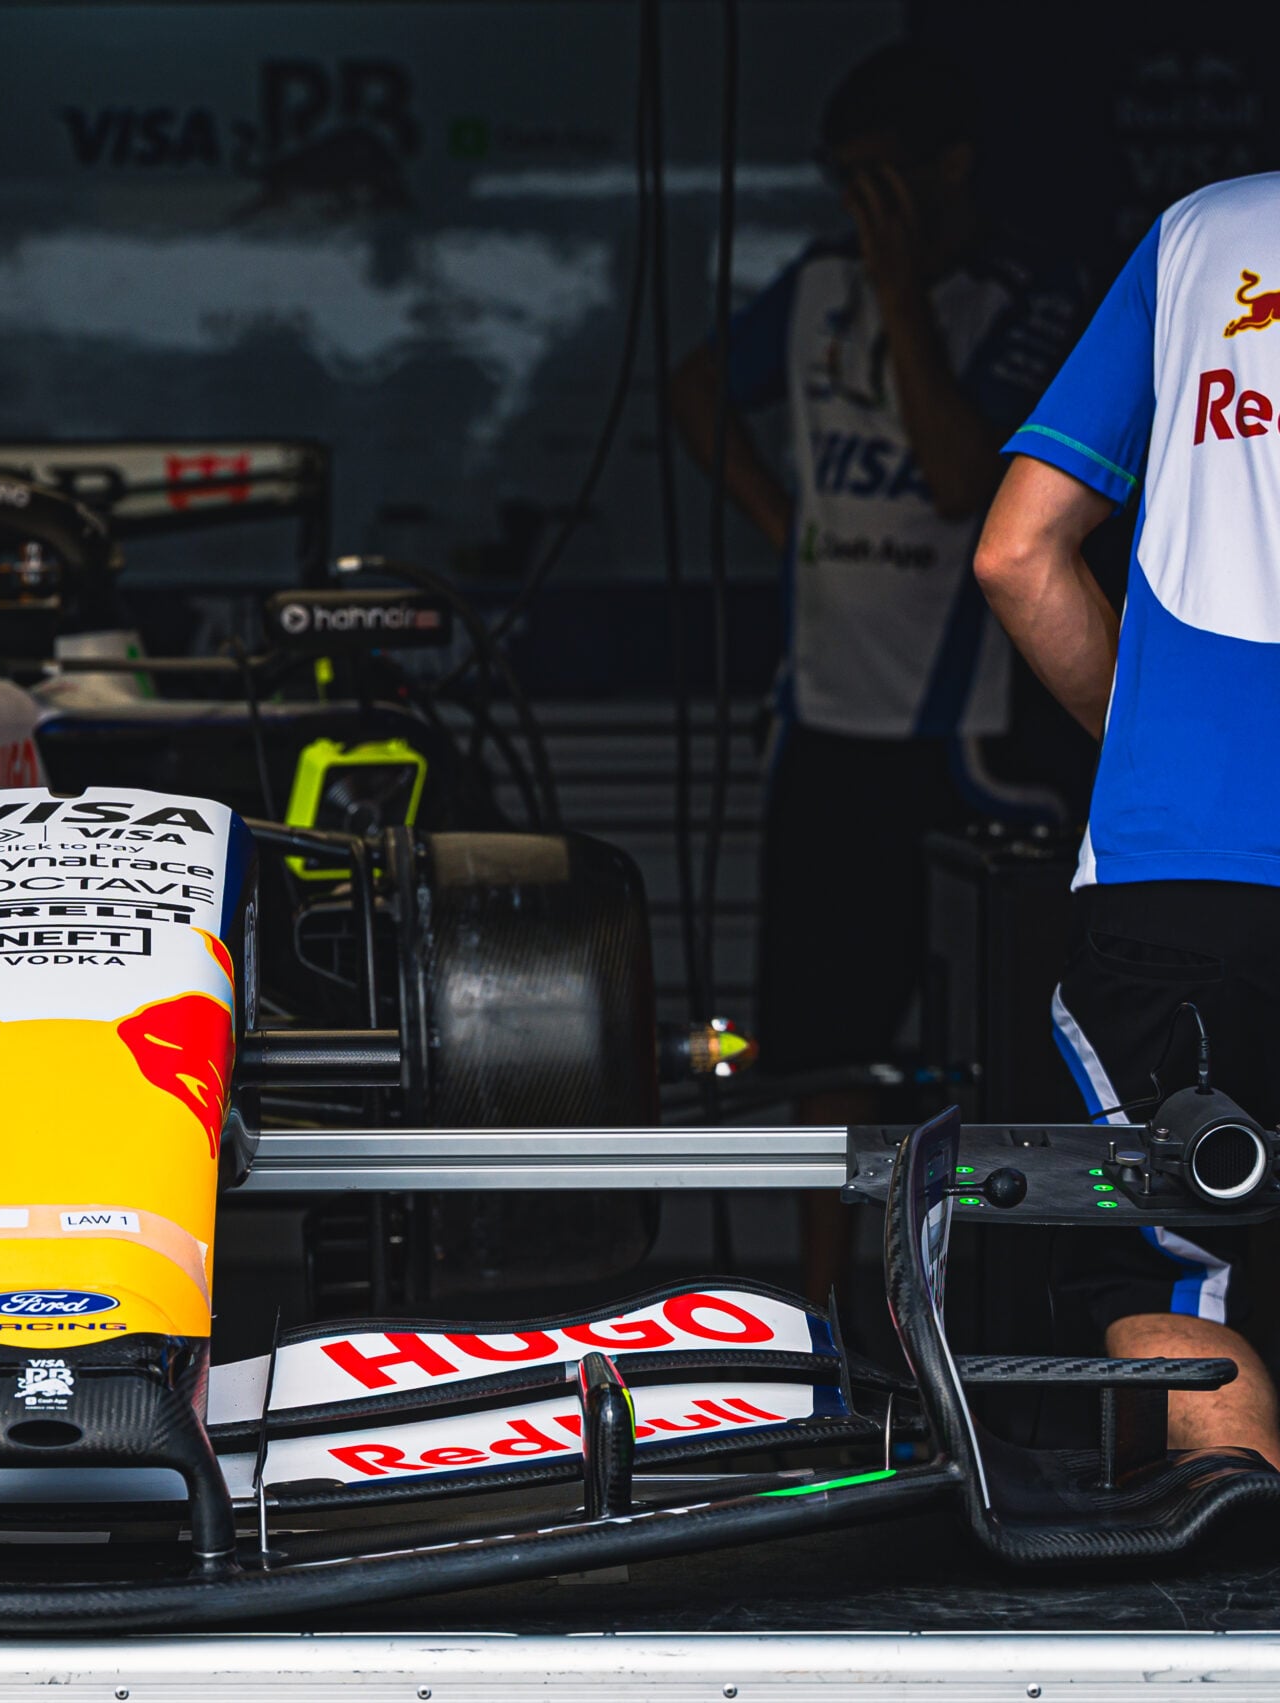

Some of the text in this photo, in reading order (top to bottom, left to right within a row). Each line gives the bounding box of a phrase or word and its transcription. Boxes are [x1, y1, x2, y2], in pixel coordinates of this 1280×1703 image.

[60, 106, 218, 167] VISA
[1193, 368, 1280, 446] Re
[312, 602, 416, 632] hahnair
[68, 827, 187, 846] VISA
[60, 842, 87, 851] to
[95, 843, 145, 854] Pay
[4, 955, 127, 967] VODKA
[67, 1215, 129, 1226] LAW 1
[1, 1294, 89, 1314] Ford
[320, 1293, 774, 1390] HUGO
[28, 1359, 65, 1367] VISA
[327, 1420, 572, 1476] Red
